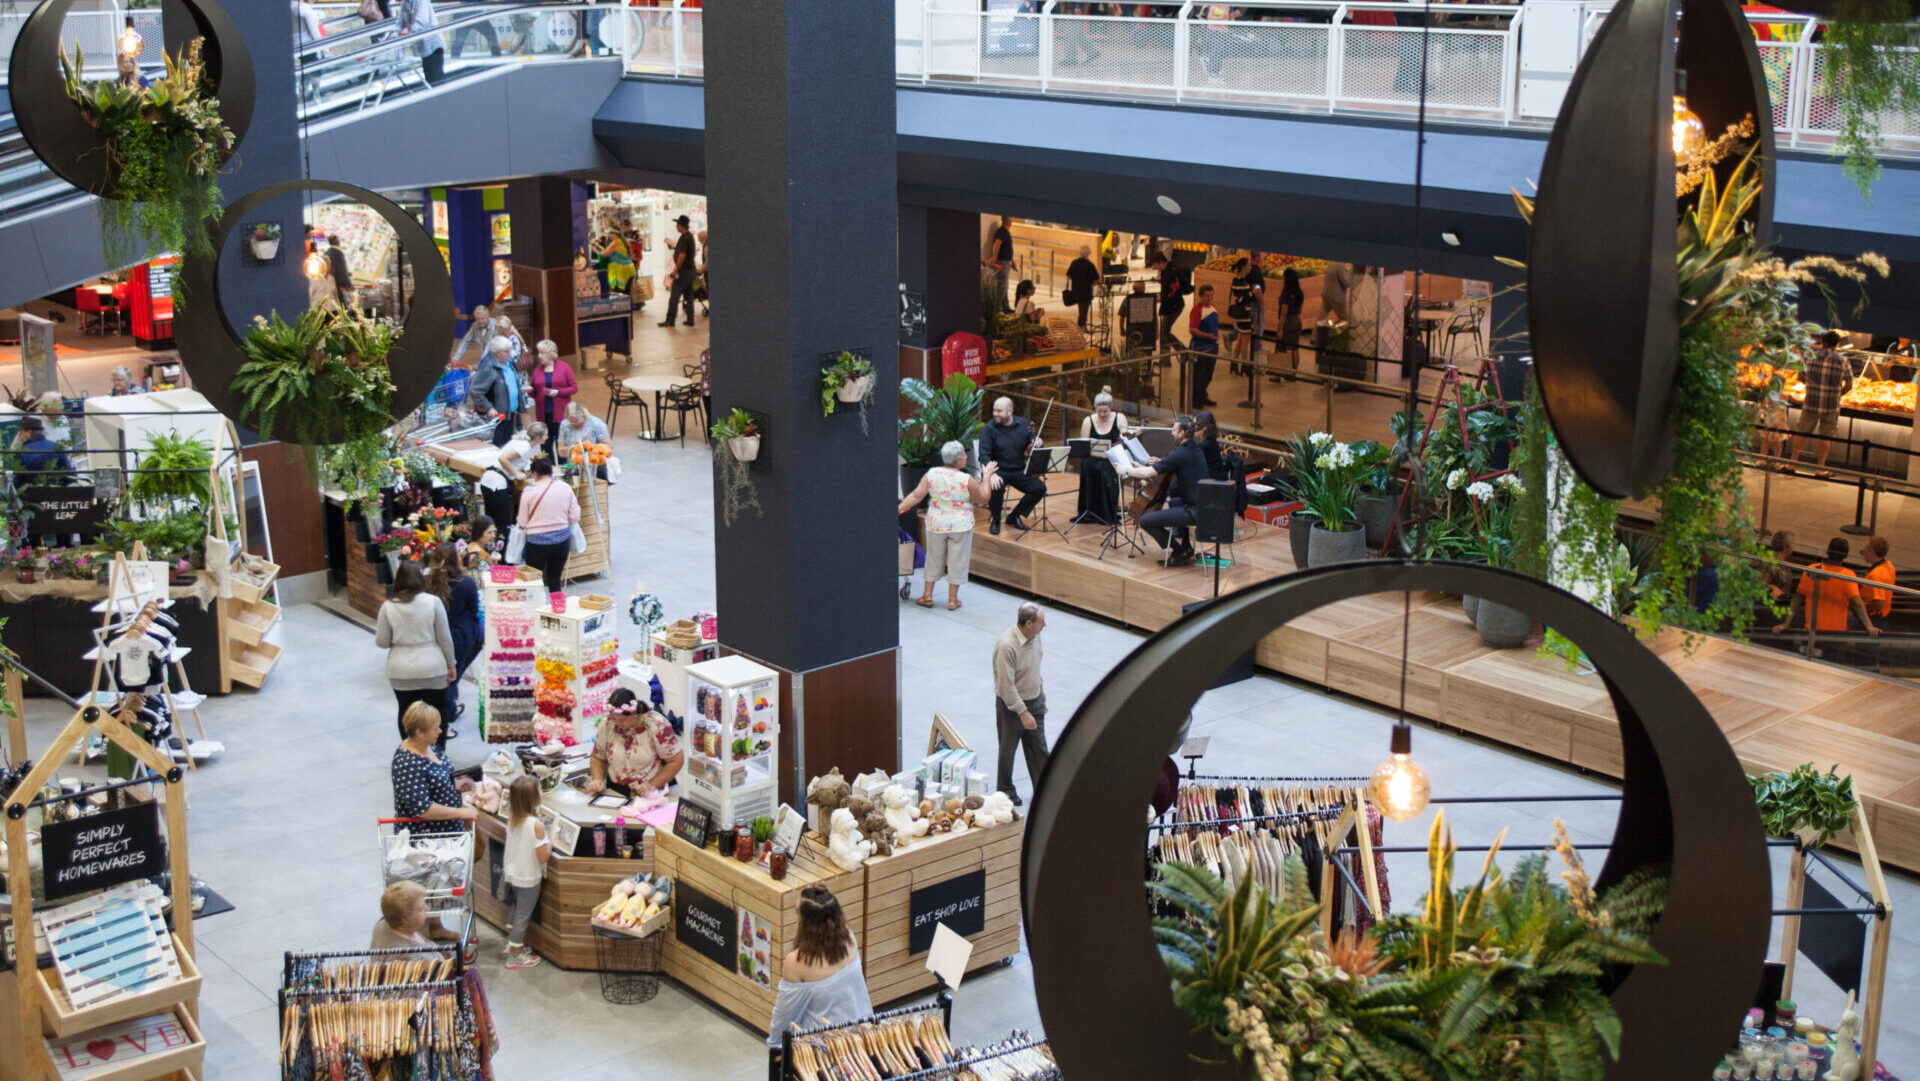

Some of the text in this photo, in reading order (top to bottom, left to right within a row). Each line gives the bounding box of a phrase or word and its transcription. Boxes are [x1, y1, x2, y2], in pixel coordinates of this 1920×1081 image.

[41, 501, 90, 510] THE LITTLE
[55, 511, 78, 520] LEAF
[77, 823, 125, 846] SIMPLY
[72, 837, 132, 863] PERFECT
[58, 851, 146, 883] HOMEWARES
[688, 904, 722, 931] GOURMET
[914, 895, 981, 928] EAT SHOP LOVE
[685, 916, 726, 947] MACARONS
